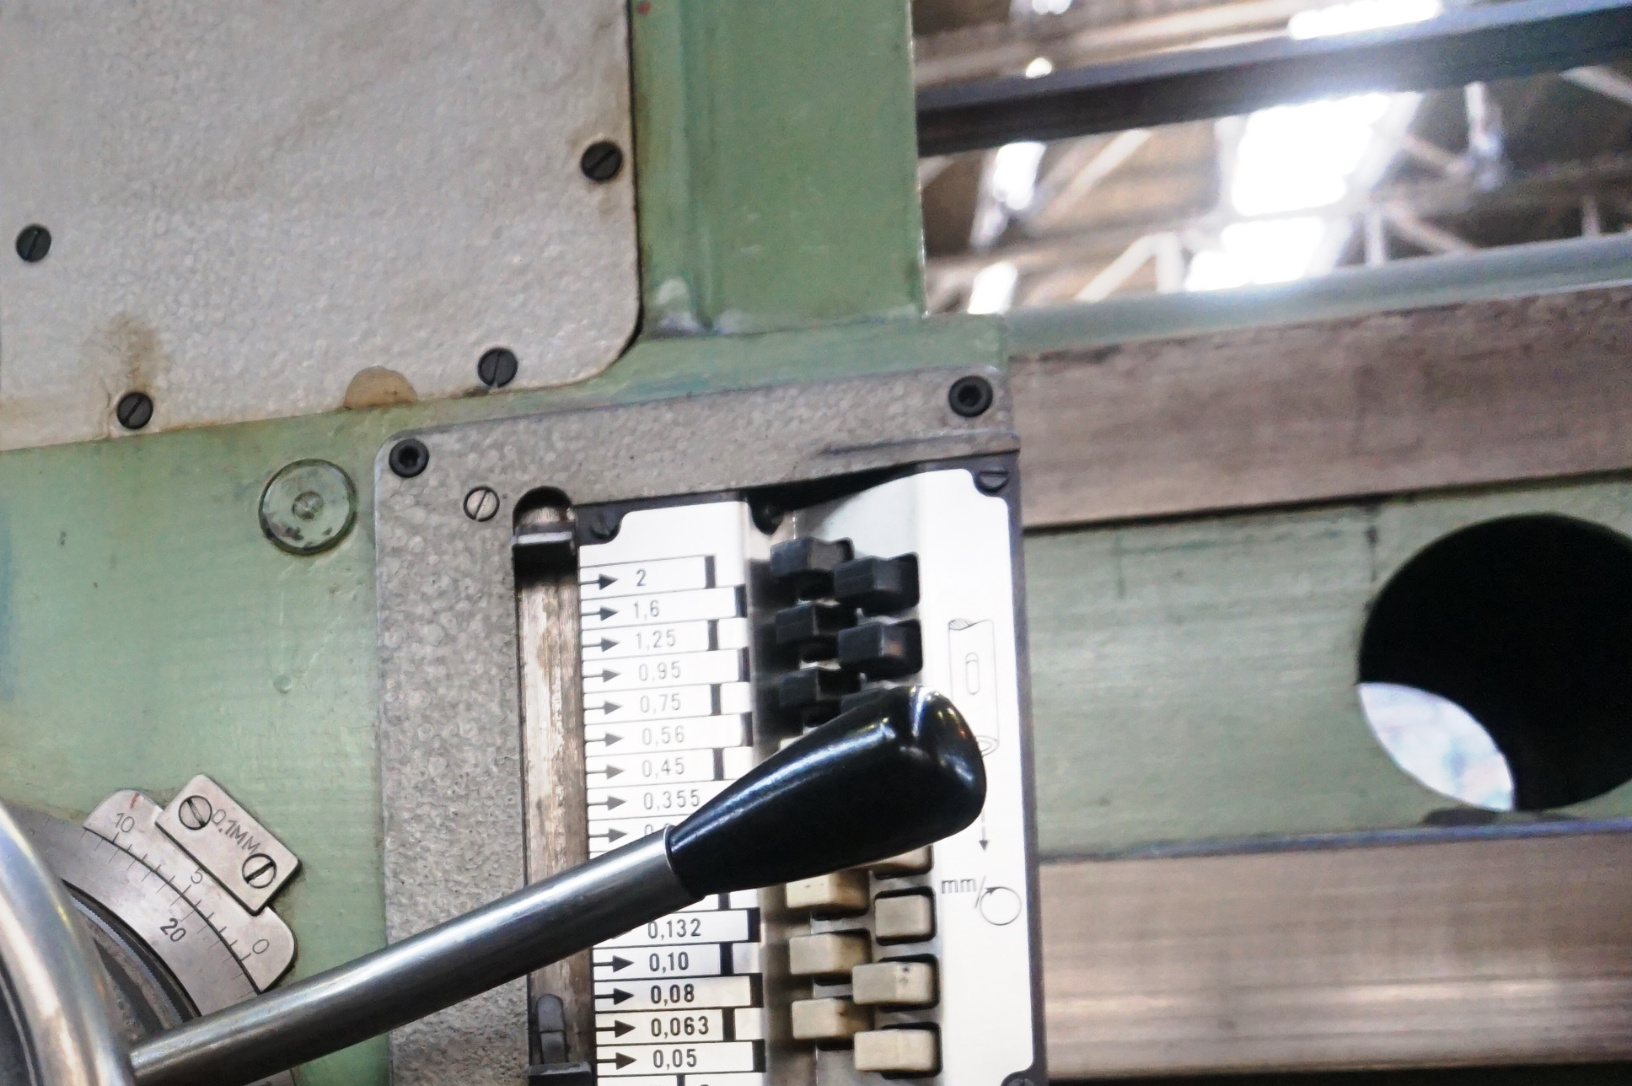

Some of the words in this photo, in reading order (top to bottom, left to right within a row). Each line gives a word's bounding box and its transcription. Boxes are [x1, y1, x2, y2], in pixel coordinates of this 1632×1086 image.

[635, 568, 647, 587] 2
[633, 600, 660, 620] 1,6
[635, 629, 676, 650] 1,25
[638, 661, 681, 683] 0,95
[639, 693, 681, 715] 0,75
[641, 725, 685, 747] 0,56
[641, 757, 685, 779] 0,45
[643, 789, 700, 811] 0,355
[115, 812, 135, 833] 10
[190, 867, 204, 885] 5
[159, 917, 187, 943] 20
[647, 918, 702, 941] 0,132
[649, 951, 689, 974] 0,10
[651, 983, 695, 1007] 0,08
[651, 1015, 709, 1039] 0,063
[653, 1048, 697, 1070] 0,05
